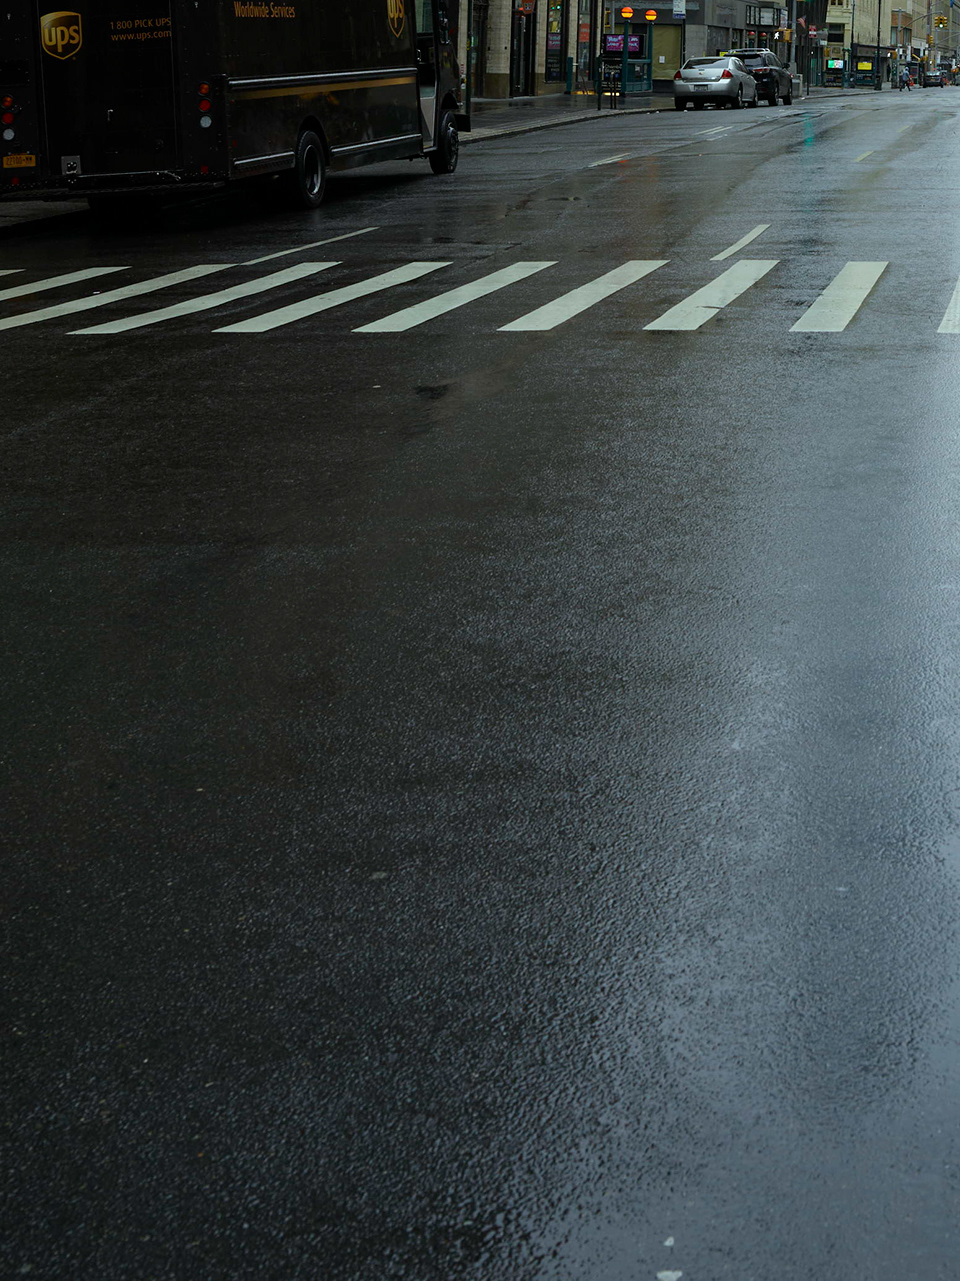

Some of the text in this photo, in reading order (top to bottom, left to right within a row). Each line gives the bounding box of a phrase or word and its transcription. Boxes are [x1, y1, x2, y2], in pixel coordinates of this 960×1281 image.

[233, 1, 296, 18] Worldwide Services
[110, 17, 172, 30] 1 800 PICK UPS
[43, 25, 80, 53] ups
[111, 29, 172, 42] www.ups.com
